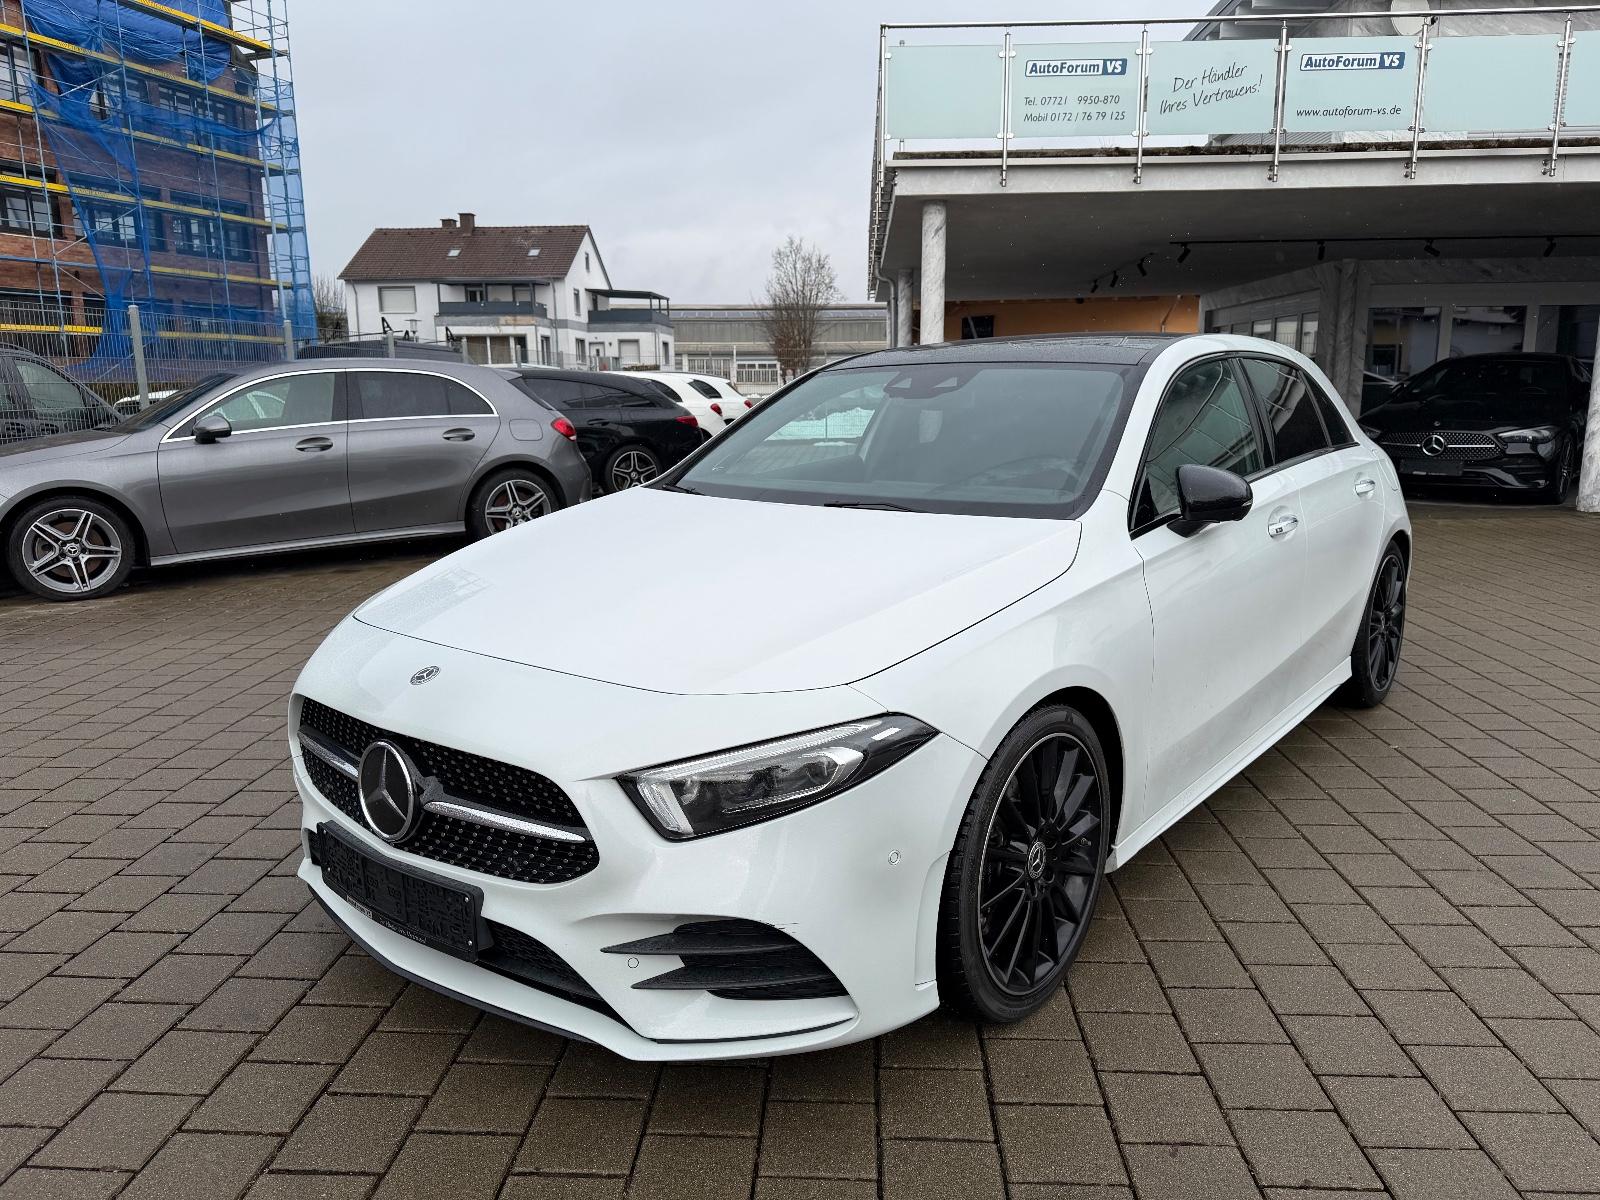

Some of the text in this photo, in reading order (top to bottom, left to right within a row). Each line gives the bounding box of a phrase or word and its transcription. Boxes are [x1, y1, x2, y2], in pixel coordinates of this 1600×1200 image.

[1029, 60, 1122, 74] AutoForum VS
[1304, 54, 1400, 68] AutoForum VS
[1173, 62, 1247, 92] Der Händler
[1024, 96, 1037, 106] Tel.
[1077, 95, 1120, 105] 9950-870
[1160, 74, 1263, 114] Ihres Vertrauens!
[1024, 112, 1048, 122] Mobil
[1050, 112, 1072, 122] 0172
[1082, 112, 1092, 121] 76
[1095, 111, 1106, 121] 79
[1110, 111, 1126, 121] 125
[1296, 105, 1402, 118] www.autoforum-vs.de
